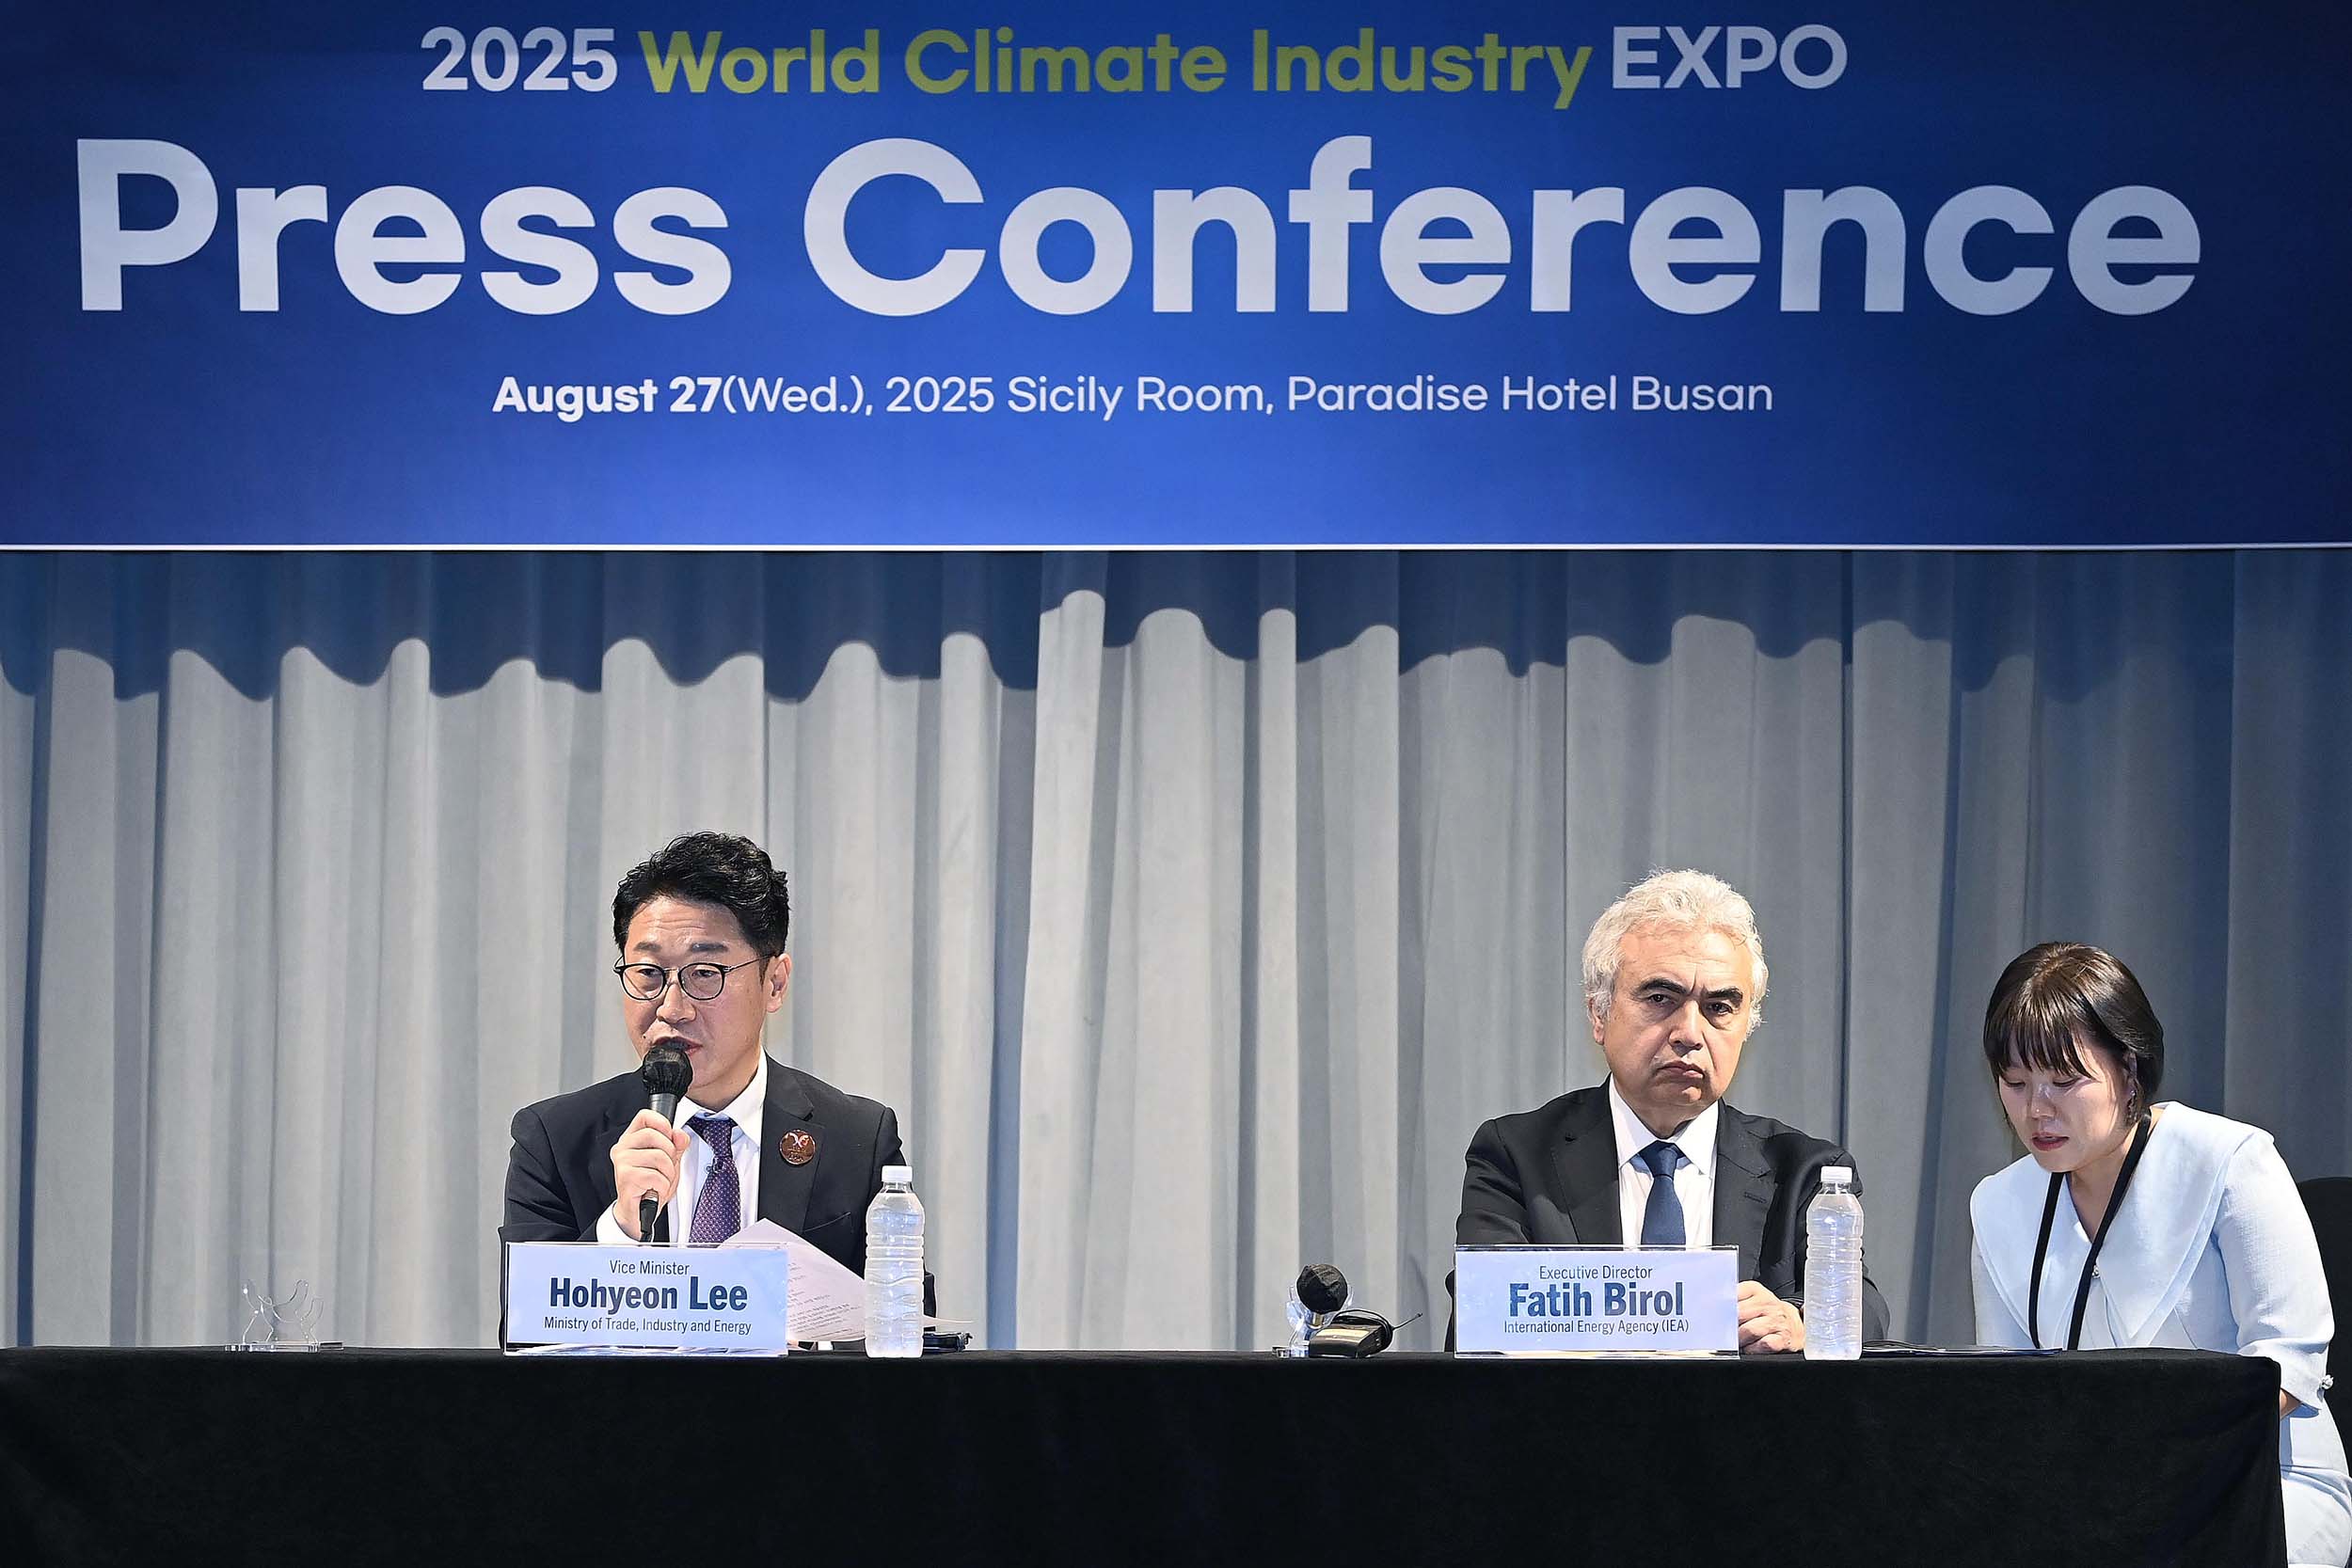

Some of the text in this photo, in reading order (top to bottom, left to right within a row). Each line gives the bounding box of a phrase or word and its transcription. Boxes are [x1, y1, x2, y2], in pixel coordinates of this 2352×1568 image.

[421, 24, 1849, 110] 2025 World Climate Industry EXPO
[76, 135, 2201, 317] Press Conference
[492, 374, 1773, 422] August 27(Wed.), 2025 Sicily Room, Paradise Hotel Busan
[609, 1259, 691, 1276] Vice Minister
[1538, 1265, 1653, 1280] Executive Director
[549, 1277, 677, 1314] Hohyeon
[689, 1276, 748, 1311] Lee
[1509, 1281, 1684, 1318] Fatih Birol
[544, 1316, 752, 1336] Ministry of Trade, Industry and Energy
[1503, 1319, 1690, 1336] International Energy Agency (IEA)
